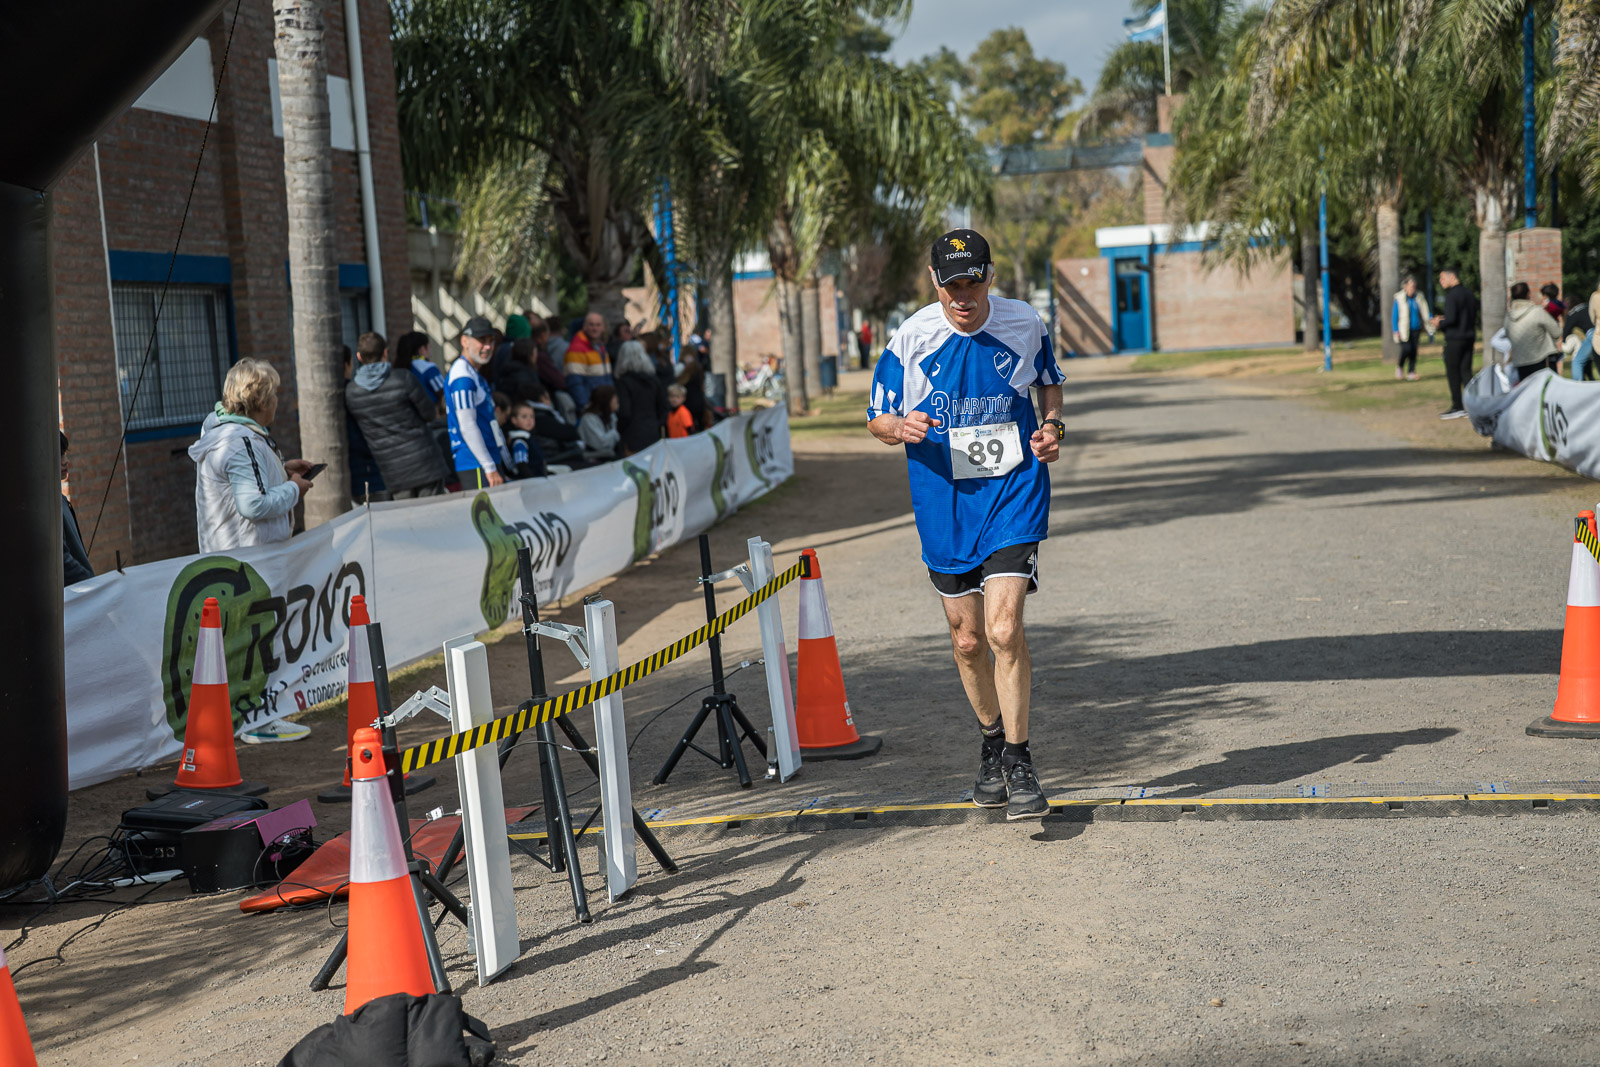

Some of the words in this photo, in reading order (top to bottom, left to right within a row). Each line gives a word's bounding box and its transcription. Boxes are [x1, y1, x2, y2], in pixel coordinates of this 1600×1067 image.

[945, 251, 972, 260] TORINO
[930, 390, 951, 434] 3
[952, 394, 1012, 416] MARATÓN
[968, 438, 1004, 466] 89
